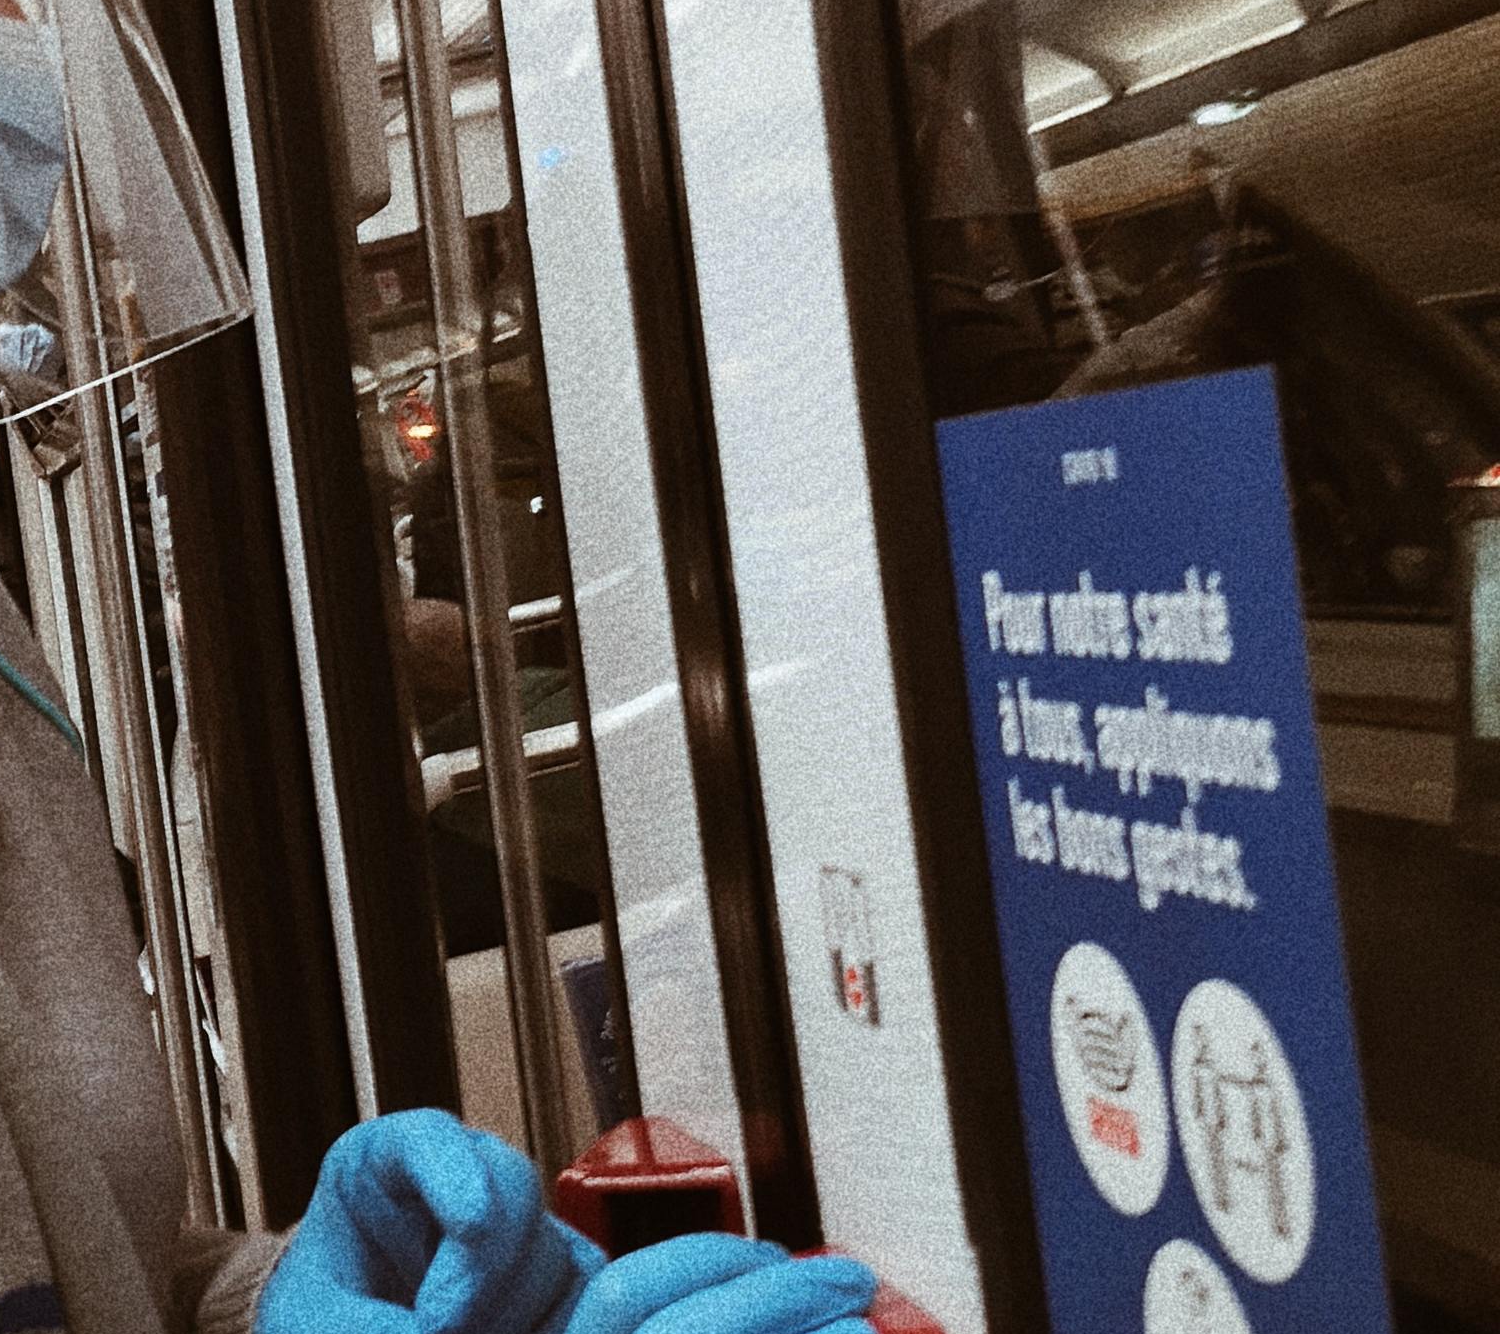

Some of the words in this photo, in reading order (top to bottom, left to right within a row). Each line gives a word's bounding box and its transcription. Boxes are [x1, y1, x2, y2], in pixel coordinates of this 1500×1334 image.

[982, 569, 1046, 655] Pour
[1133, 566, 1234, 664] santé
[1008, 775, 1055, 865] les
[1052, 785, 1131, 881] bons
